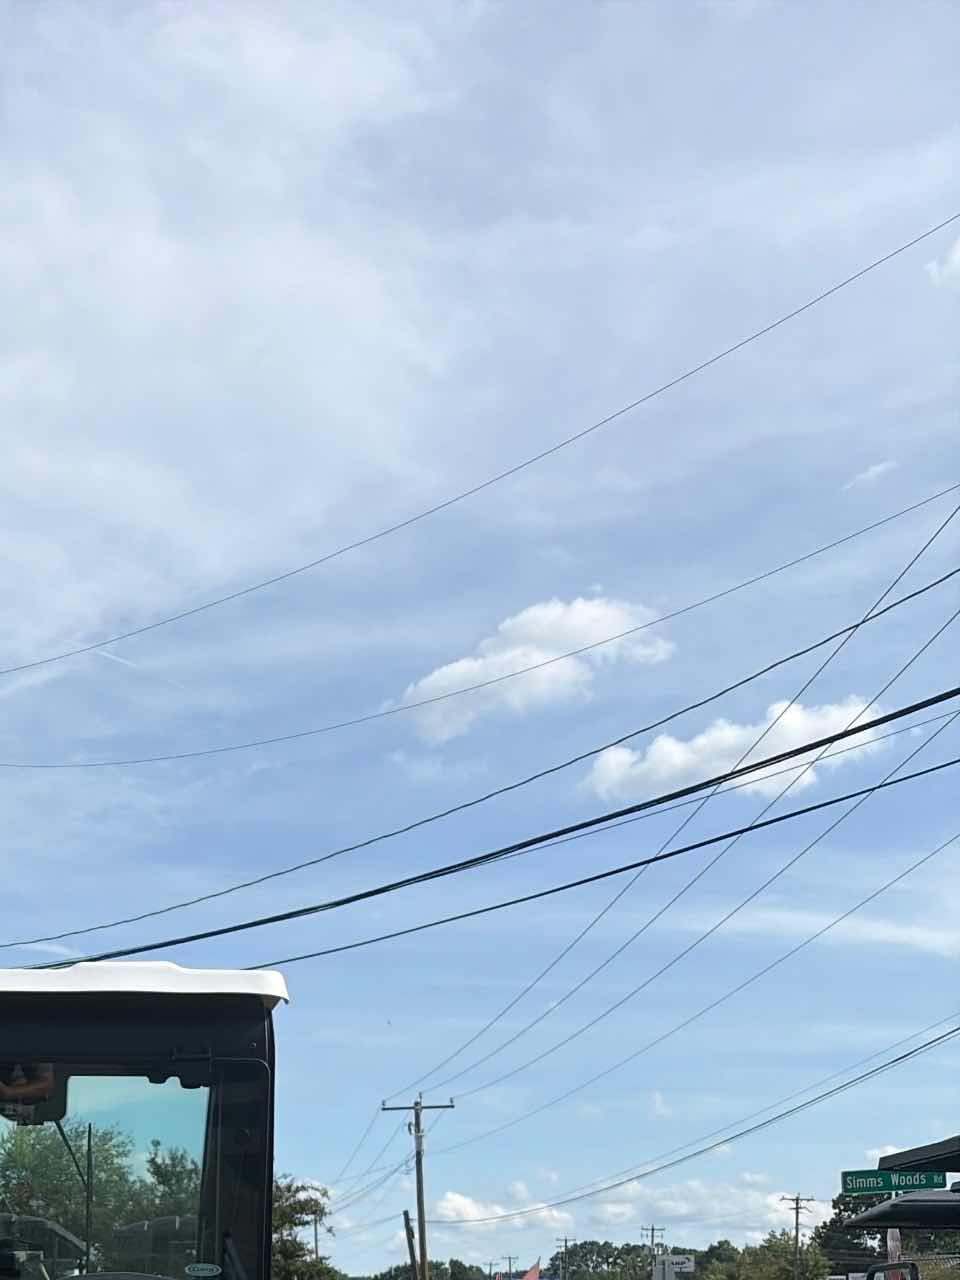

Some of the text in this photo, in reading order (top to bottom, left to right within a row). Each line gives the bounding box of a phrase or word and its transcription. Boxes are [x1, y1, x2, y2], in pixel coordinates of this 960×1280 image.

[847, 1173, 943, 1188] Simms Woods Rd
